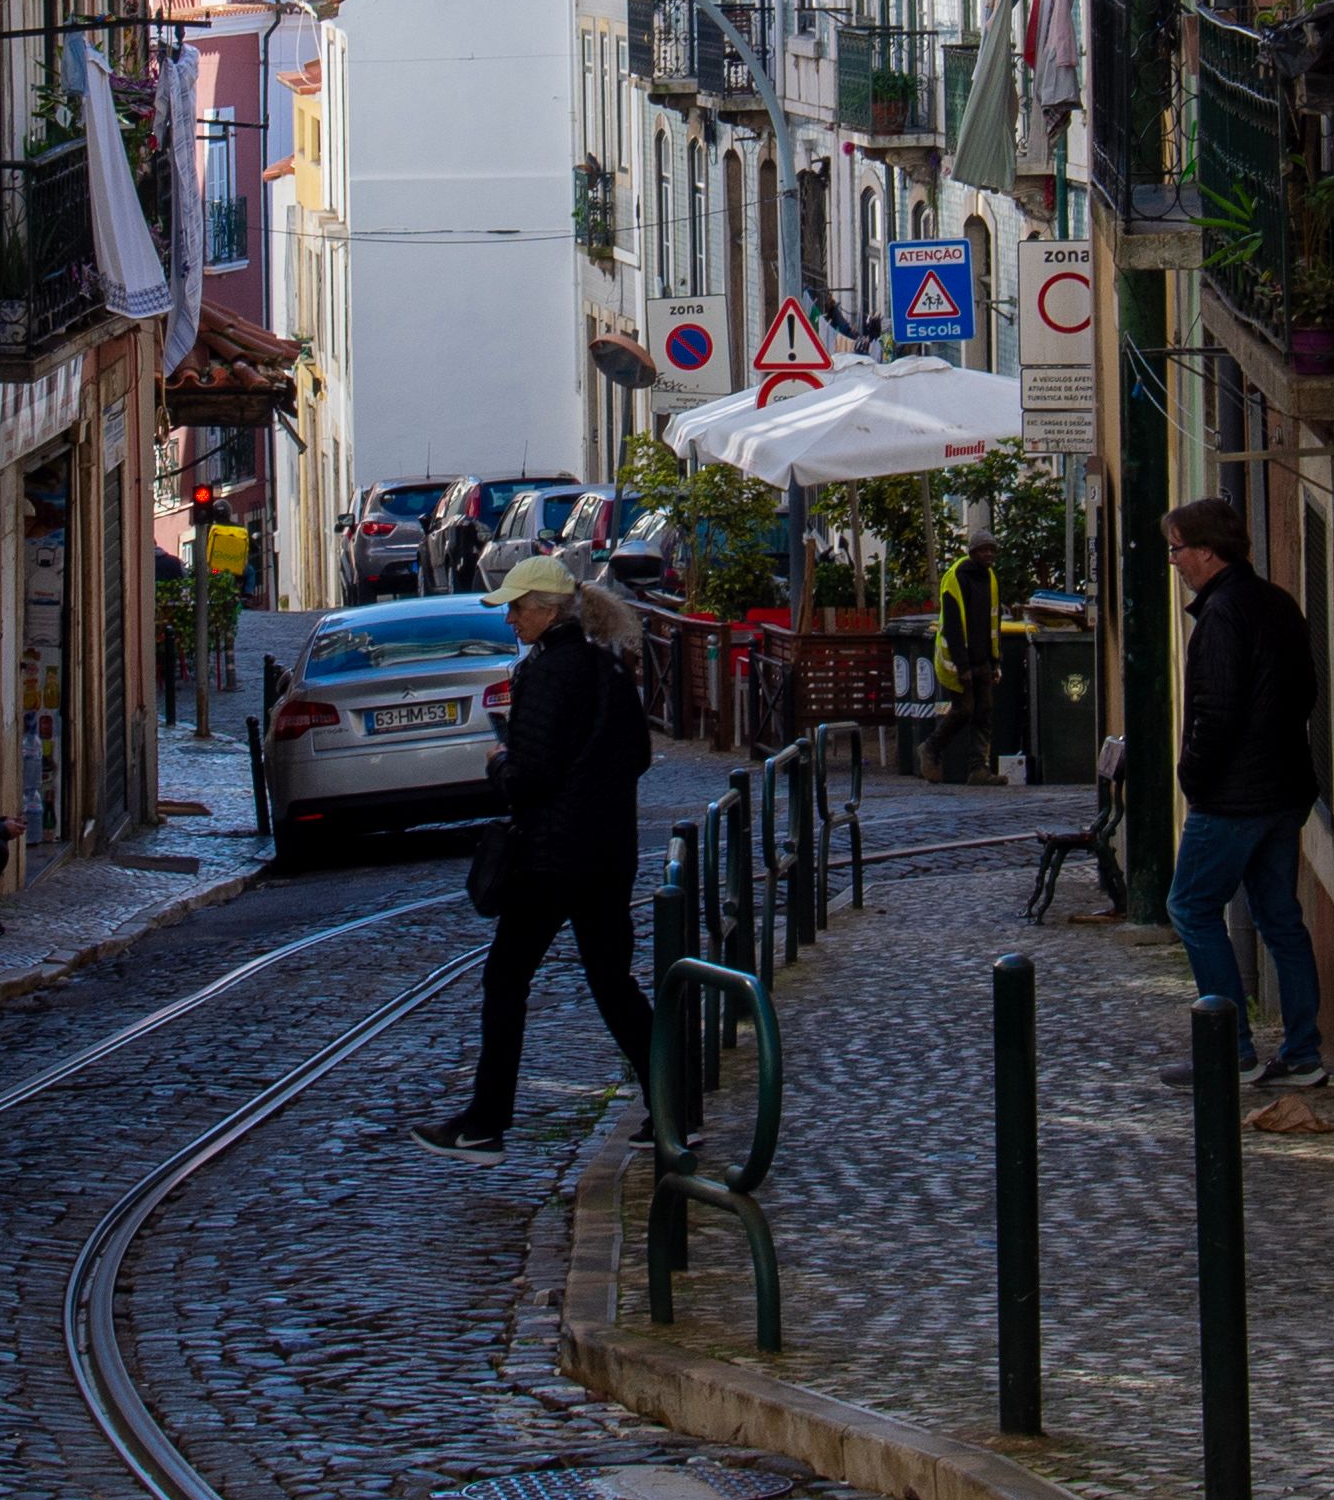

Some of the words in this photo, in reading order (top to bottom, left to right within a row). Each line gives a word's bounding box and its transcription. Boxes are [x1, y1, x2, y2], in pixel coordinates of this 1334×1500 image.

[898, 247, 963, 263] ATENÇÃO
[1044, 249, 1090, 263] zona
[670, 304, 704, 316] zona
[906, 322, 961, 337] Escola
